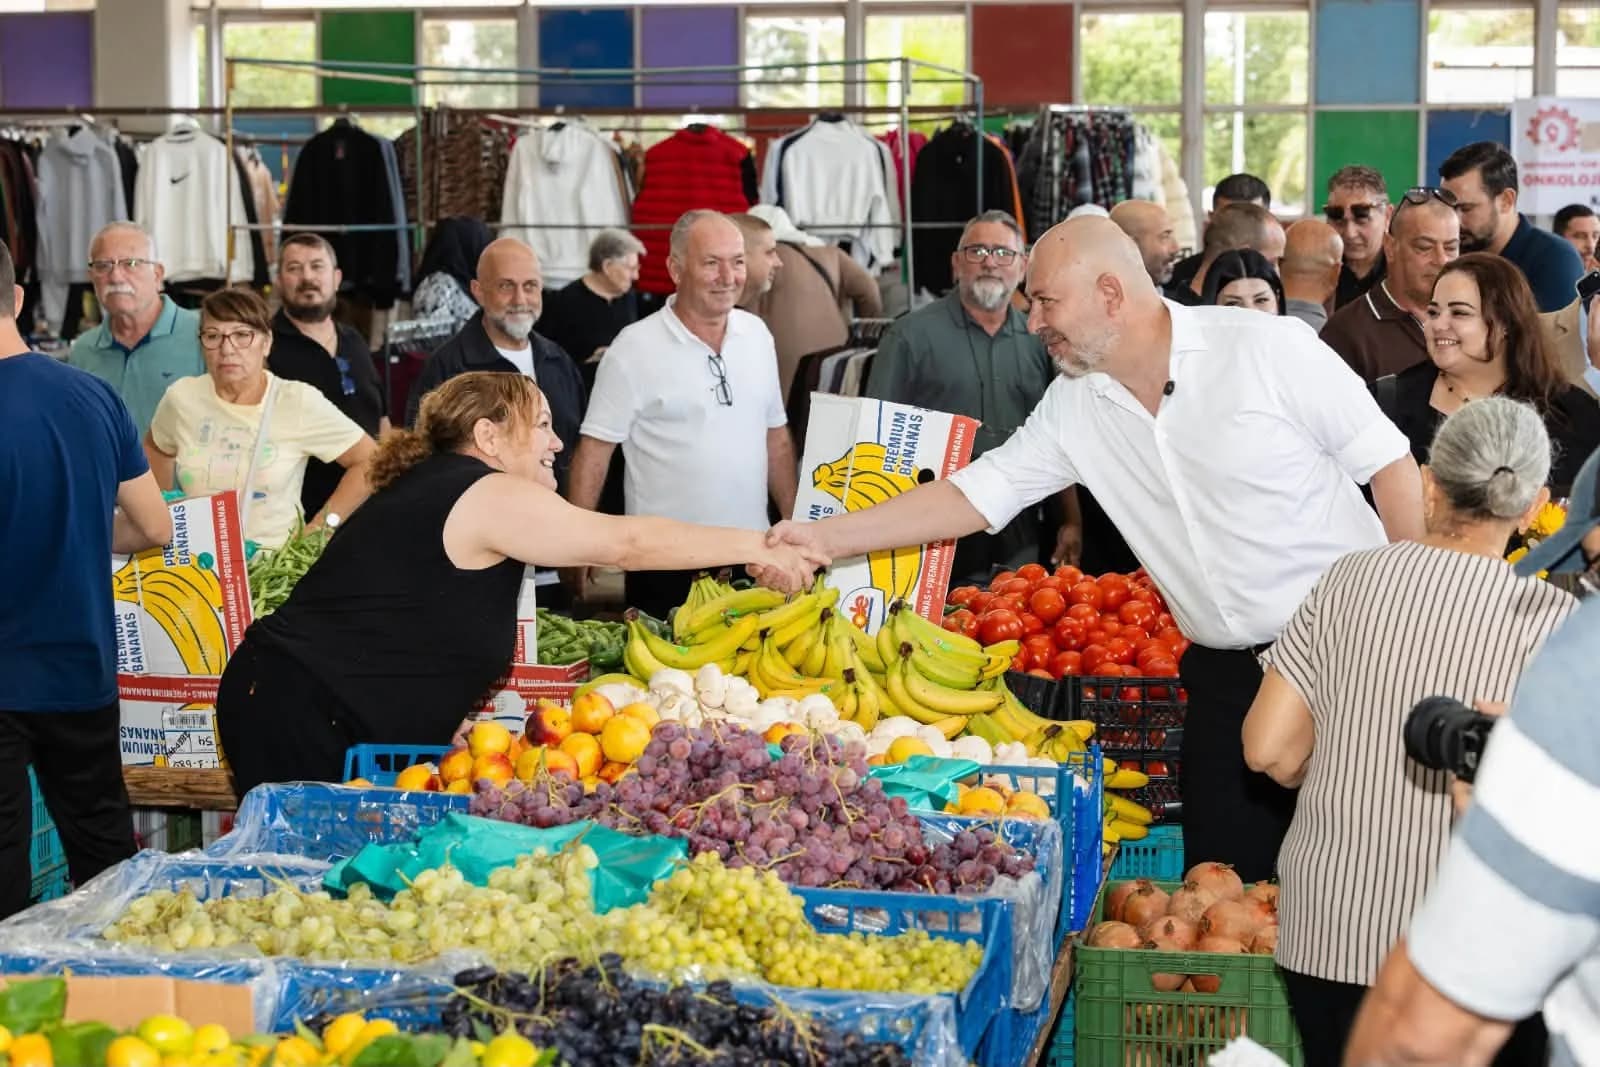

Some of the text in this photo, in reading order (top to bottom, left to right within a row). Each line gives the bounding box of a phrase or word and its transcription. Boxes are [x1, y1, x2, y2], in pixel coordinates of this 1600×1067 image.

[883, 412, 907, 472] PREMIUM
[899, 414, 923, 476] BANANAS
[216, 500, 229, 540] BANANAS
[927, 550, 942, 588] PREMIUM
[952, 422, 967, 462] BANANAS
[173, 505, 191, 565] BANANAS
[219, 539, 233, 579] PREMIUM
[225, 583, 240, 627] BANANAS
[124, 612, 144, 672] BANANAS
[152, 688, 187, 699] PREMIUM
[120, 726, 166, 741] ANANAS
